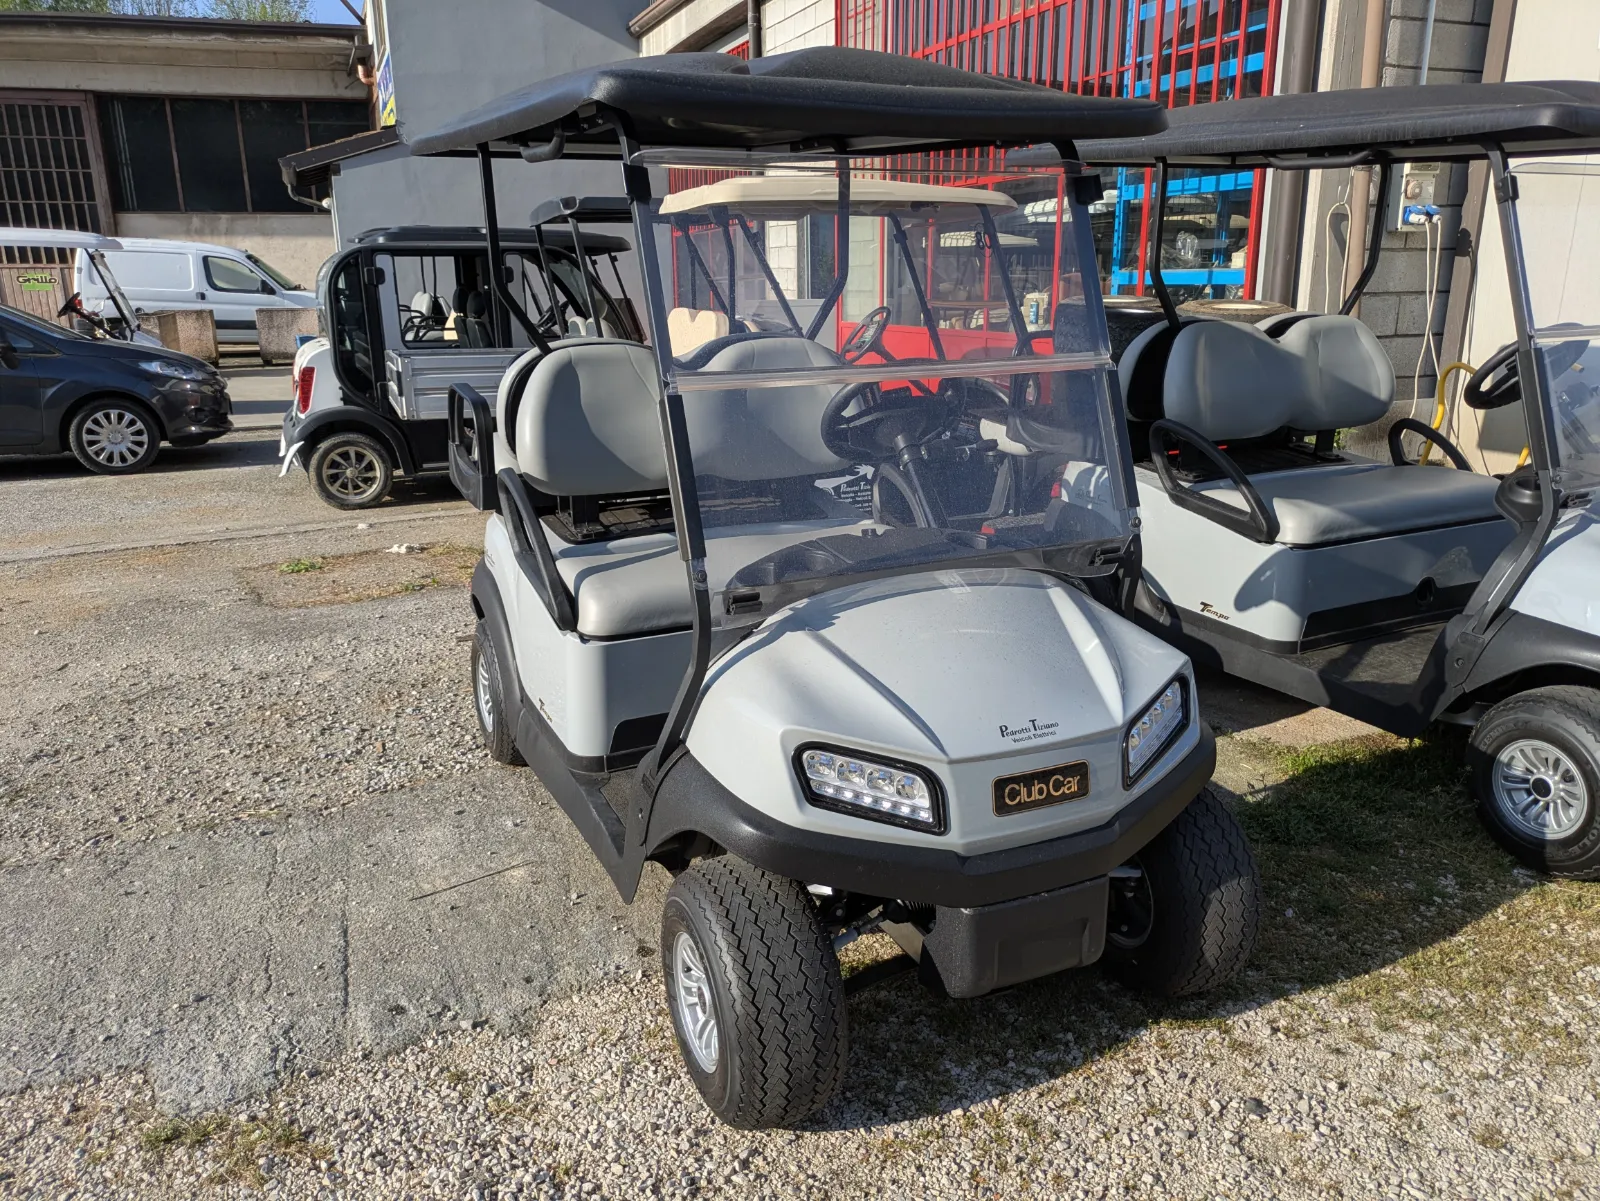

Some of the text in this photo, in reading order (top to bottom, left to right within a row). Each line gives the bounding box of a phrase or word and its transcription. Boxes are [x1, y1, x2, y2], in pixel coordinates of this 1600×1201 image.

[16, 275, 58, 284] Grillo
[1199, 601, 1230, 620] Tempo
[999, 718, 1059, 738] Pedrotti Tiziano
[1004, 774, 1080, 805] Club Car
